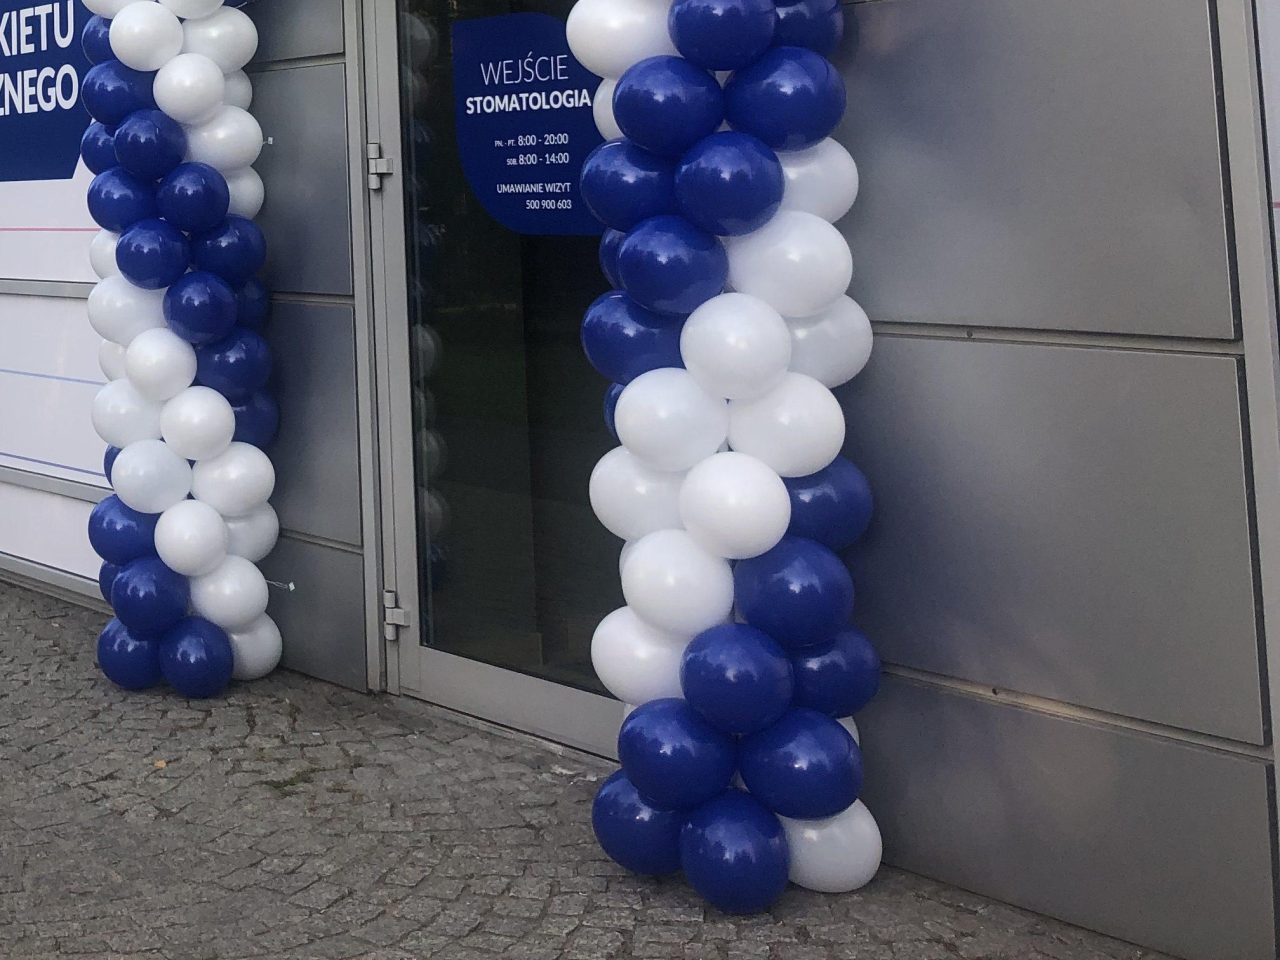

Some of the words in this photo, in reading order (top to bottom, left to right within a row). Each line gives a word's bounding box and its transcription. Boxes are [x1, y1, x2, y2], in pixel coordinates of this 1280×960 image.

[480, 51, 569, 85] WEJŚCIE
[466, 88, 592, 114] STOMATOLOGIA
[517, 135, 537, 146] 8:00
[543, 133, 569, 145] 20:00
[518, 153, 537, 165] 8:00
[544, 152, 570, 164] 14:00
[496, 183, 544, 193] UMAWIANIE
[544, 182, 572, 193] WIZYT
[525, 199, 540, 209] 500
[541, 199, 556, 209] 900
[557, 199, 572, 209] 603
